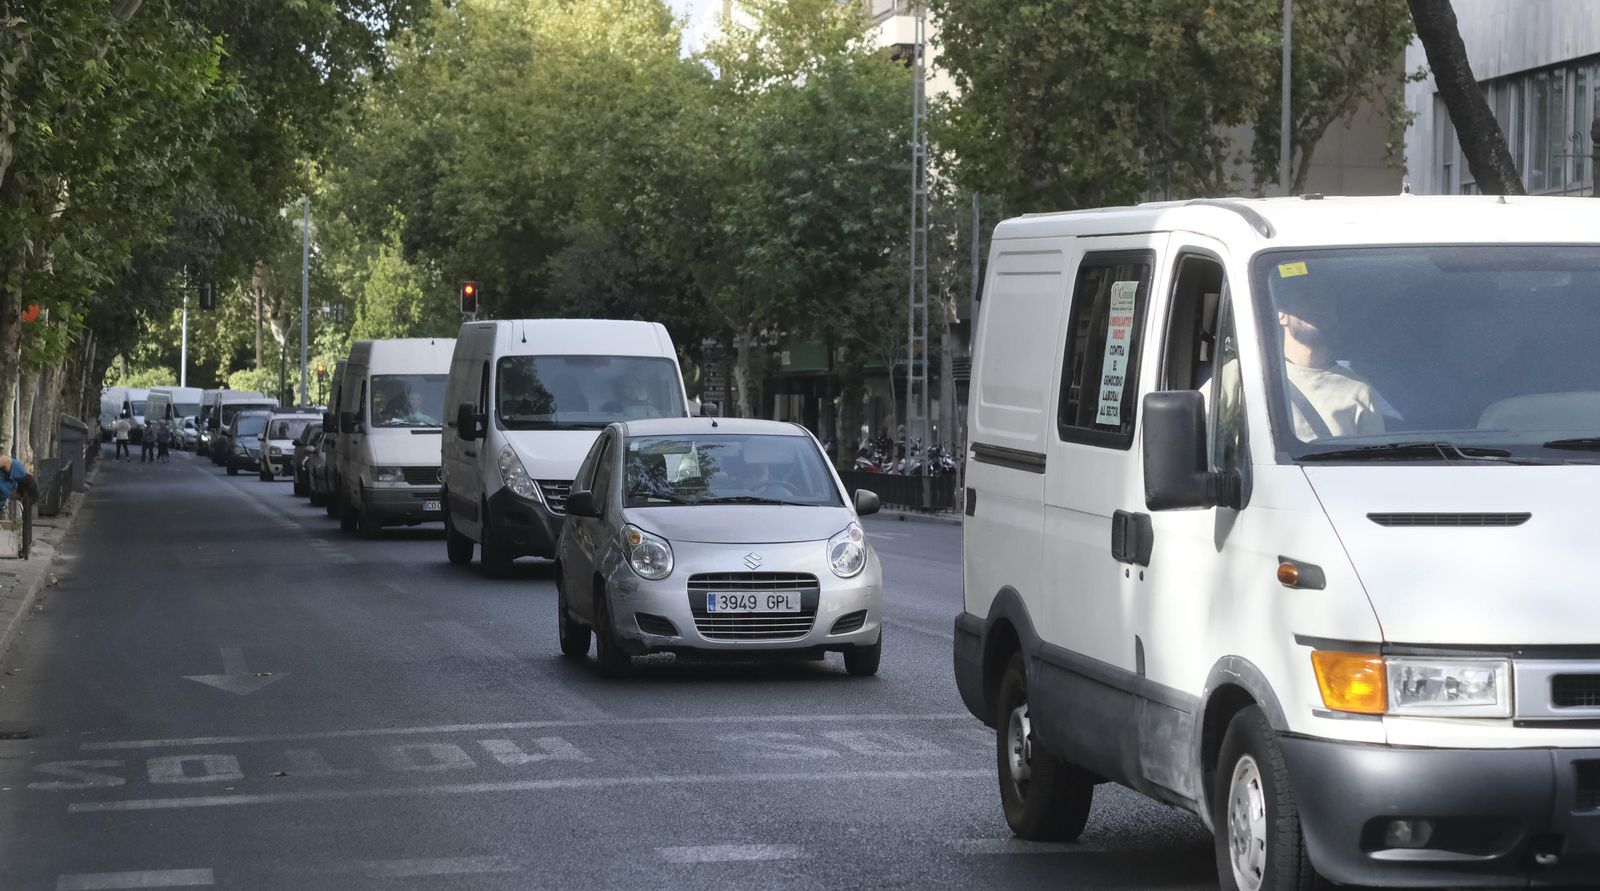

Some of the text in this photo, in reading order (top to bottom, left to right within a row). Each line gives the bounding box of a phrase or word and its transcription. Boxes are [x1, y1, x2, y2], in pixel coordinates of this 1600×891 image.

[1109, 345, 1124, 356] CONTRA
[719, 594, 794, 610] 3949 GPL
